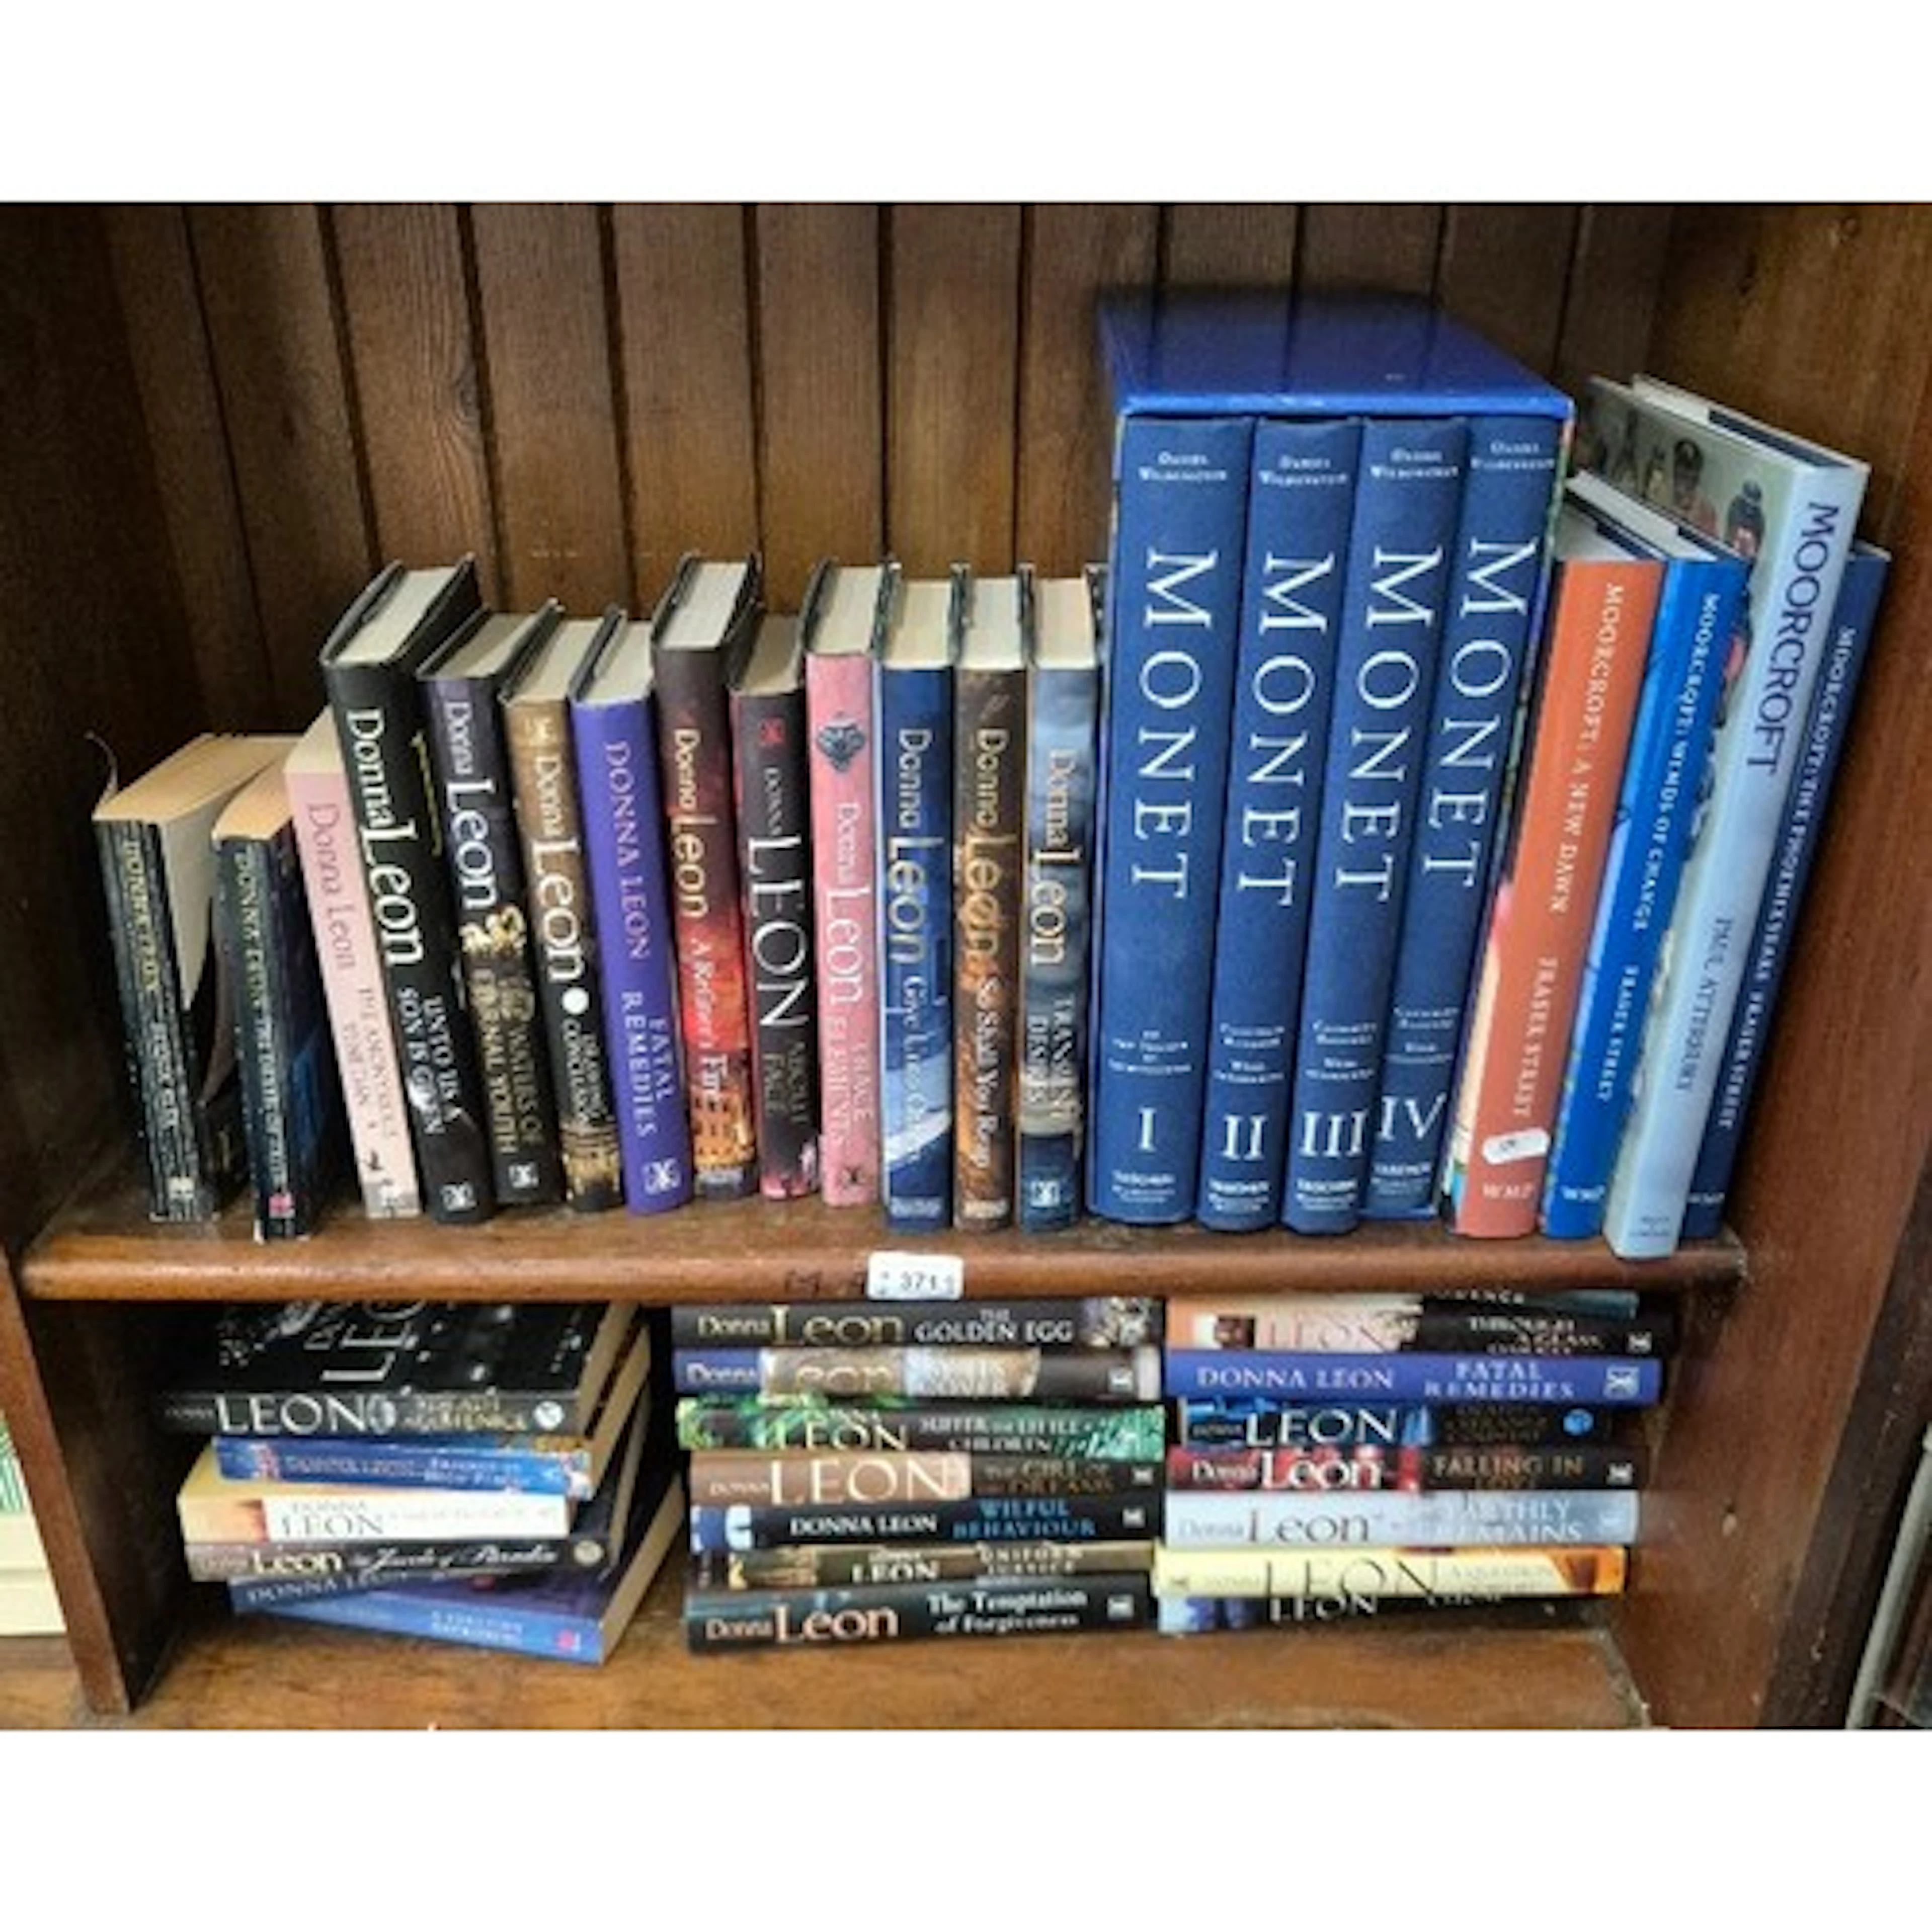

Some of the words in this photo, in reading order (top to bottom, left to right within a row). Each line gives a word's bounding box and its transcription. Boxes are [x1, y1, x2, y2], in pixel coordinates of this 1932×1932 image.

[1744, 497, 1840, 778] MOORCROFT
[444, 699, 479, 777] Donna
[1132, 549, 1218, 898] MONET
[1237, 551, 1333, 906] MONET
[1335, 546, 1442, 902] MONET
[1422, 537, 1538, 888] MONET
[344, 705, 400, 831] Donna
[531, 754, 568, 838] Donna
[604, 740, 641, 867] DONNA
[673, 727, 704, 809] Donna
[898, 728, 931, 829] Donna
[975, 727, 1008, 827] Donna
[1042, 747, 1074, 846] Donna
[306, 798, 355, 898] Donna
[443, 776, 507, 913] Leon
[670, 811, 721, 920] Leon
[835, 801, 861, 886] Donna
[357, 817, 434, 970] Leon
[530, 834, 591, 984] Leon
[618, 876, 652, 961] LEON
[748, 834, 810, 1029] LEON
[888, 835, 943, 963] Leon
[961, 833, 1016, 966] Leon
[1027, 846, 1083, 967] Leon
[326, 902, 364, 972] Leon
[822, 886, 872, 1005] Leon
[394, 984, 426, 1038] SON
[420, 993, 453, 1068] UNTO
[977, 979, 999, 1006] So
[404, 1040, 430, 1065] IS
[619, 989, 657, 1137] REMEDIES
[974, 1011, 999, 1064] Shall
[486, 1073, 518, 1155] YOUTH
[1222, 1113, 1268, 1160] II
[1302, 1109, 1369, 1158] III
[1378, 1091, 1447, 1141] IV
[774, 1304, 902, 1345] Leon
[915, 1320, 1017, 1342] GOLDEN
[1026, 1319, 1074, 1342] EGG
[1196, 1366, 1305, 1388] DONNA
[1315, 1366, 1393, 1388] LEON
[1423, 1381, 1575, 1399] REMEDIES
[1456, 1361, 1543, 1381] FATAL
[213, 1392, 366, 1433] LEON
[1247, 1408, 1397, 1446] LEON
[771, 1459, 949, 1504] LEON
[1261, 1451, 1381, 1489] Leon
[283, 1514, 384, 1536] LEON
[790, 1515, 873, 1535] DONNA
[879, 1514, 937, 1533] LEON
[1247, 1508, 1370, 1542] Leon
[851, 1561, 940, 1582] LEON
[927, 1592, 967, 1614] The
[775, 1604, 899, 1643] Leon
